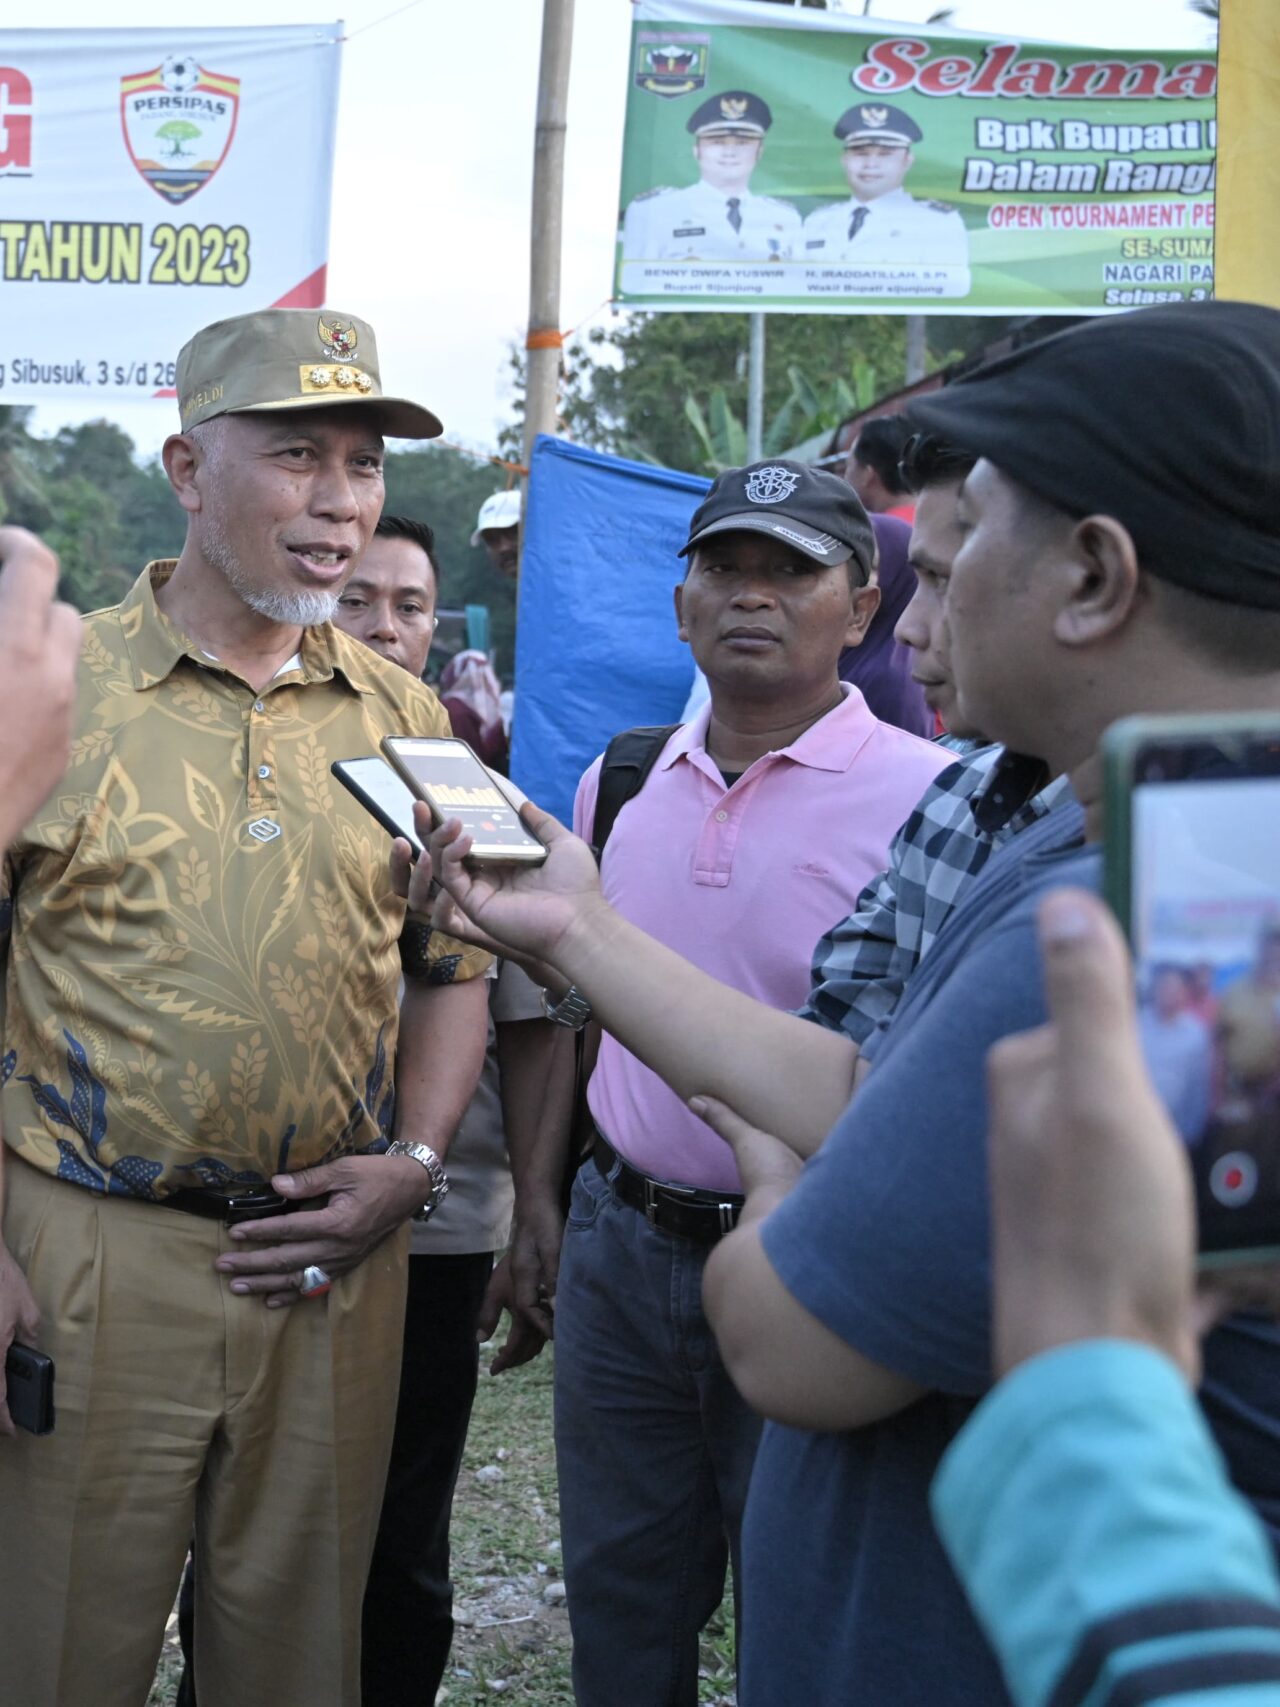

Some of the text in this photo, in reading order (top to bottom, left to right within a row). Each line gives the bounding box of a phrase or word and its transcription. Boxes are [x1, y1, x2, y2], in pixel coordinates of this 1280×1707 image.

[854, 39, 1216, 97] Selama
[133, 95, 227, 115] PERSIPAS
[976, 118, 1057, 153] Bpk
[1062, 119, 1201, 153] Bupati
[963, 158, 1098, 192] Dalam
[990, 204, 1043, 228] OPEN
[1049, 203, 1187, 228] TOURNAMENT
[150, 223, 250, 288] 2023
[1104, 264, 1182, 283] NAGARI
[11, 358, 91, 386] Sibusuk,
[97, 361, 108, 386] 3
[114, 361, 148, 387] s/d
[153, 362, 176, 387] 26
